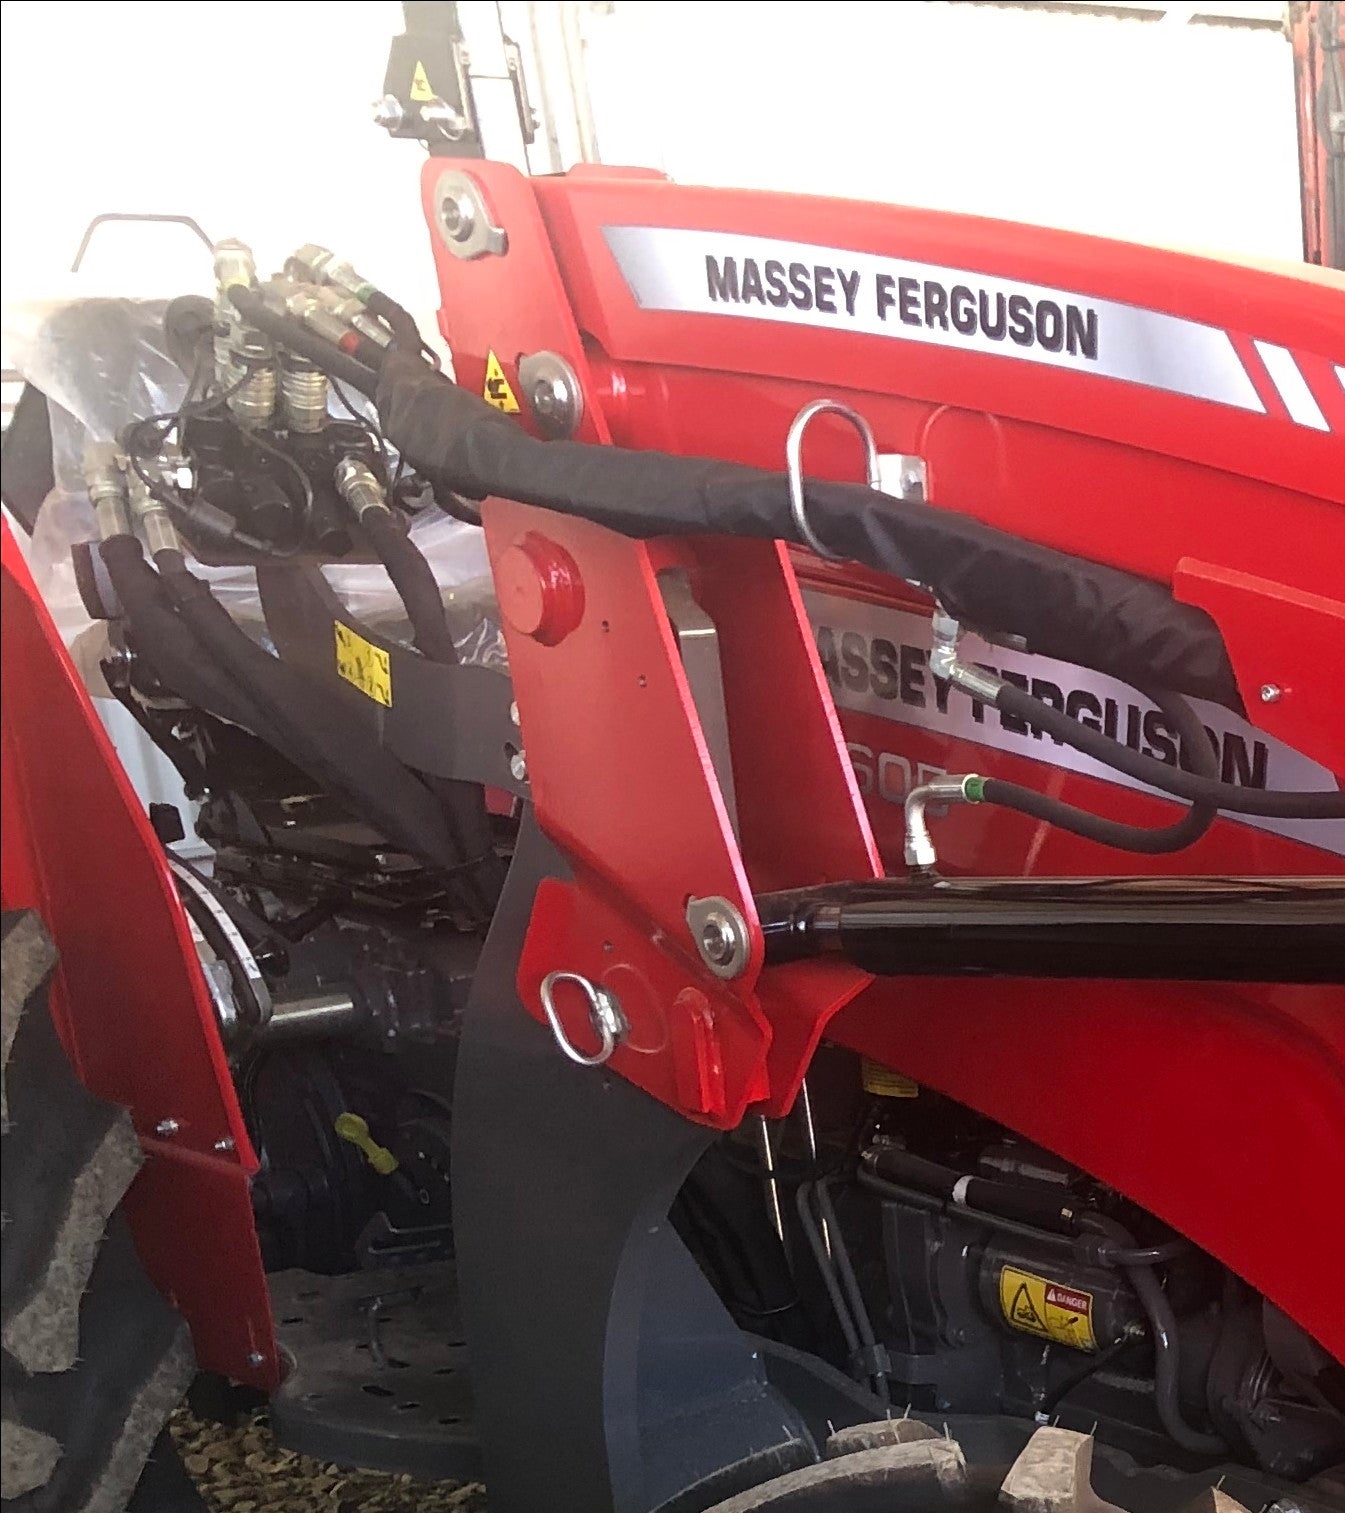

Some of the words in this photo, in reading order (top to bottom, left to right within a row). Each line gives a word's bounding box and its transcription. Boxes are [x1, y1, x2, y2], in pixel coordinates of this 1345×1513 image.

[705, 255, 859, 316] MASSEY
[876, 274, 1098, 360] FERGUSON
[815, 626, 952, 714] ASSEY
[1056, 1292, 1088, 1310] DANGER
